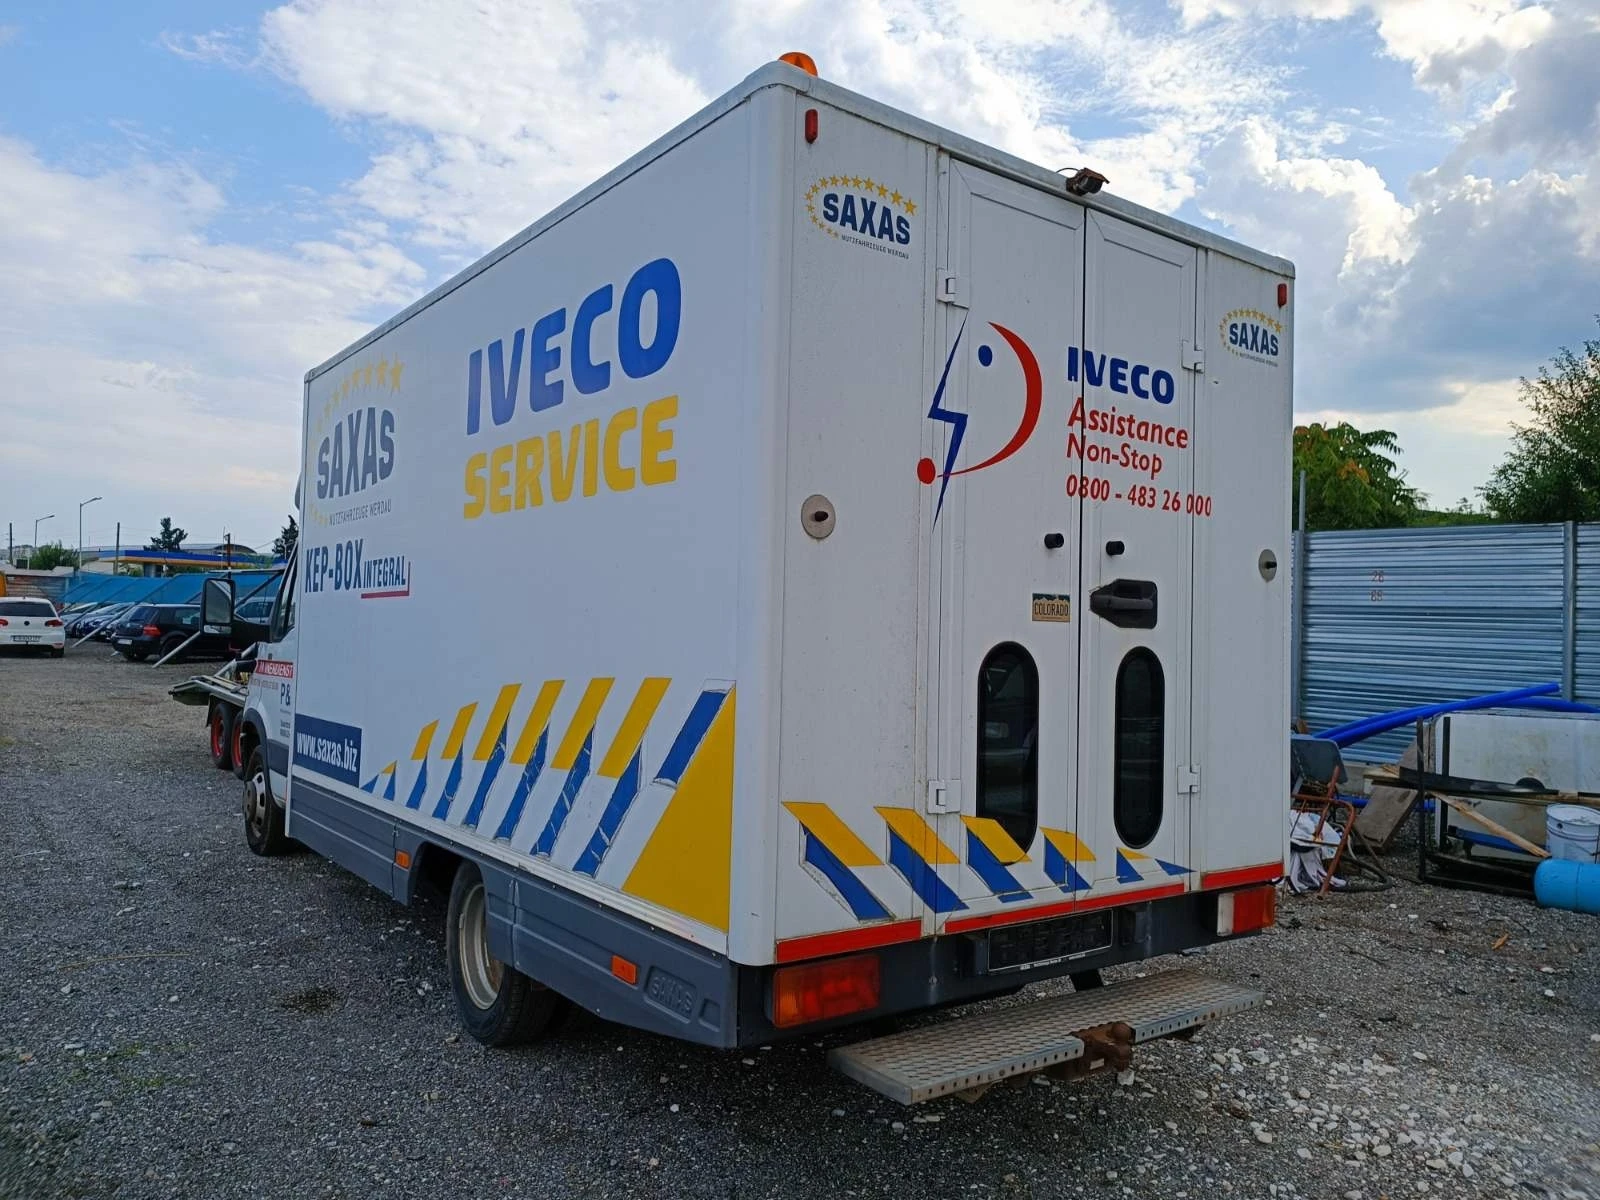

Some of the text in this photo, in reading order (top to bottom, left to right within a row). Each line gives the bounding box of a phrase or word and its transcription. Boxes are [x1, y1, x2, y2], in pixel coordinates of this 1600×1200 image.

[823, 193, 910, 245] SAXAS
[467, 257, 682, 435] IVECO
[1229, 322, 1279, 356] SAXAS
[1067, 346, 1174, 404] IVECO
[1067, 397, 1188, 449] Assistance
[317, 407, 395, 499] SAXAS
[463, 395, 679, 519] SERVICE
[1066, 432, 1162, 480] Non-Stop
[1066, 474, 1110, 502] 0800
[1127, 484, 1156, 508] 483
[1162, 491, 1181, 512] 26
[1186, 494, 1212, 517] 000
[305, 538, 406, 593] KEP-BOX INTEGRAL
[1034, 602, 1069, 617] COLORADO
[296, 732, 358, 773] www.saxas.biz
